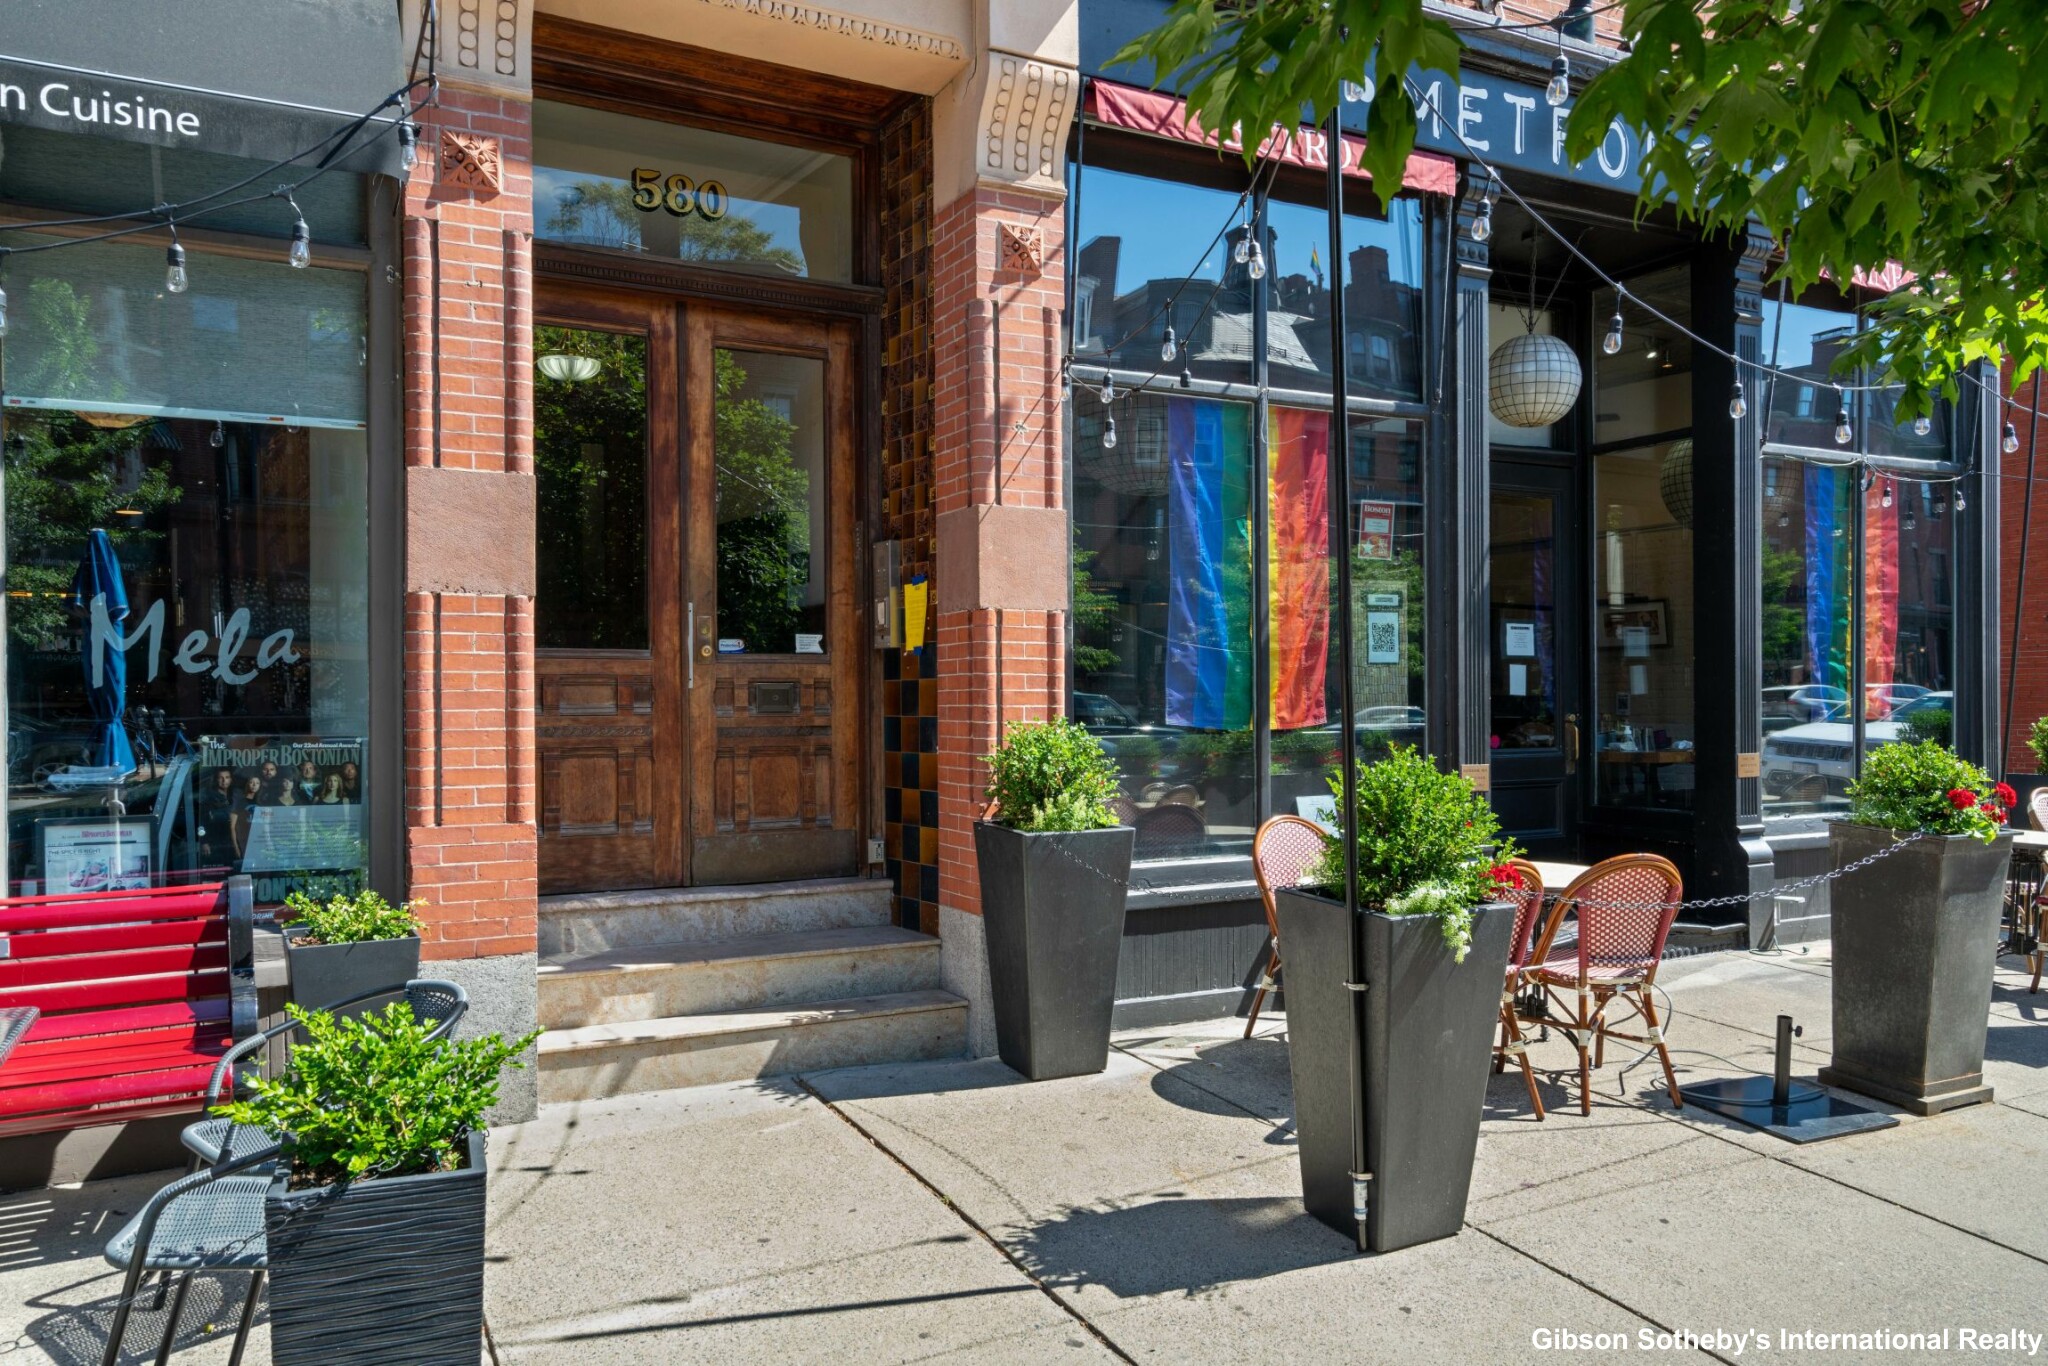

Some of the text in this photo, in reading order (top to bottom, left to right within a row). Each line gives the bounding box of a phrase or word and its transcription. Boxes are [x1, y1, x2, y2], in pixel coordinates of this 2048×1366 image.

[40, 83, 200, 136] Cuisine
[631, 168, 728, 222] 580
[1364, 504, 1391, 514] Boston
[90, 592, 300, 688] Mela
[201, 744, 360, 768] IMPROPER BOSTONIAN
[209, 737, 226, 749] The
